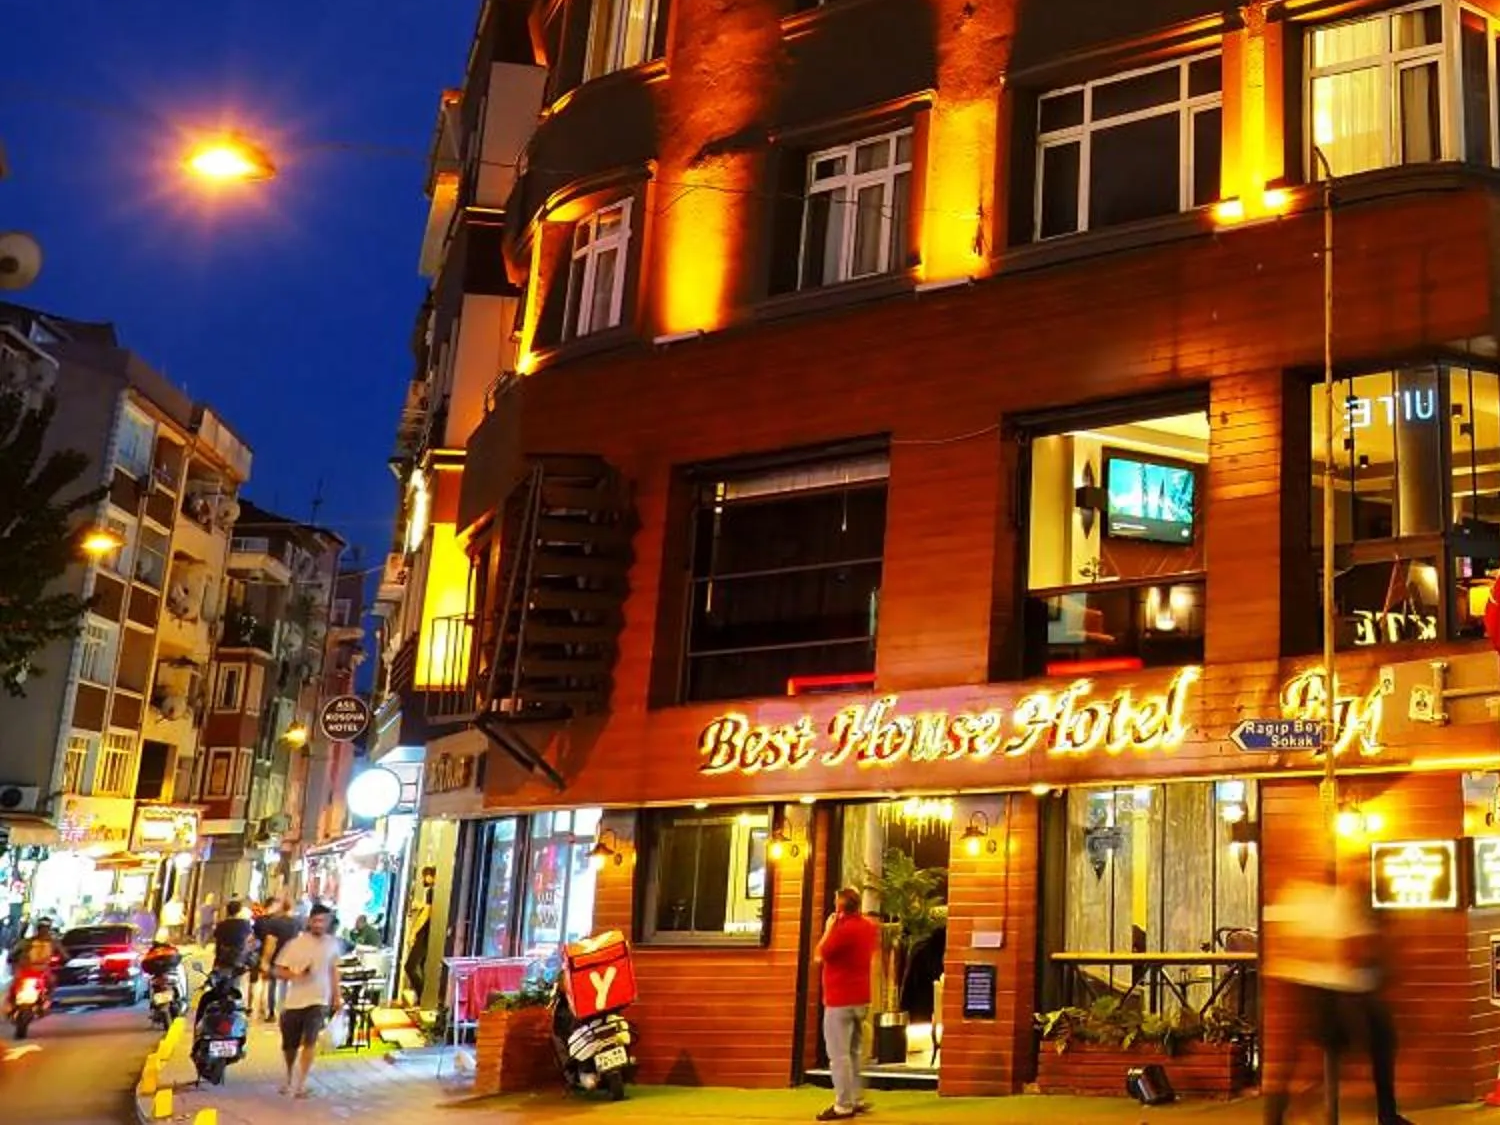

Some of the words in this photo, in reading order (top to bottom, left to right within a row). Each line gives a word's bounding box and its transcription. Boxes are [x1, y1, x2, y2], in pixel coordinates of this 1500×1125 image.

[327, 722, 358, 732] HOTEL
[698, 711, 817, 775] Best
[821, 693, 1001, 768] House
[1004, 664, 1202, 757] Hotel
[1294, 720, 1322, 735] Bey
[1270, 734, 1313, 748] Sokak
[589, 965, 617, 1012] Y
